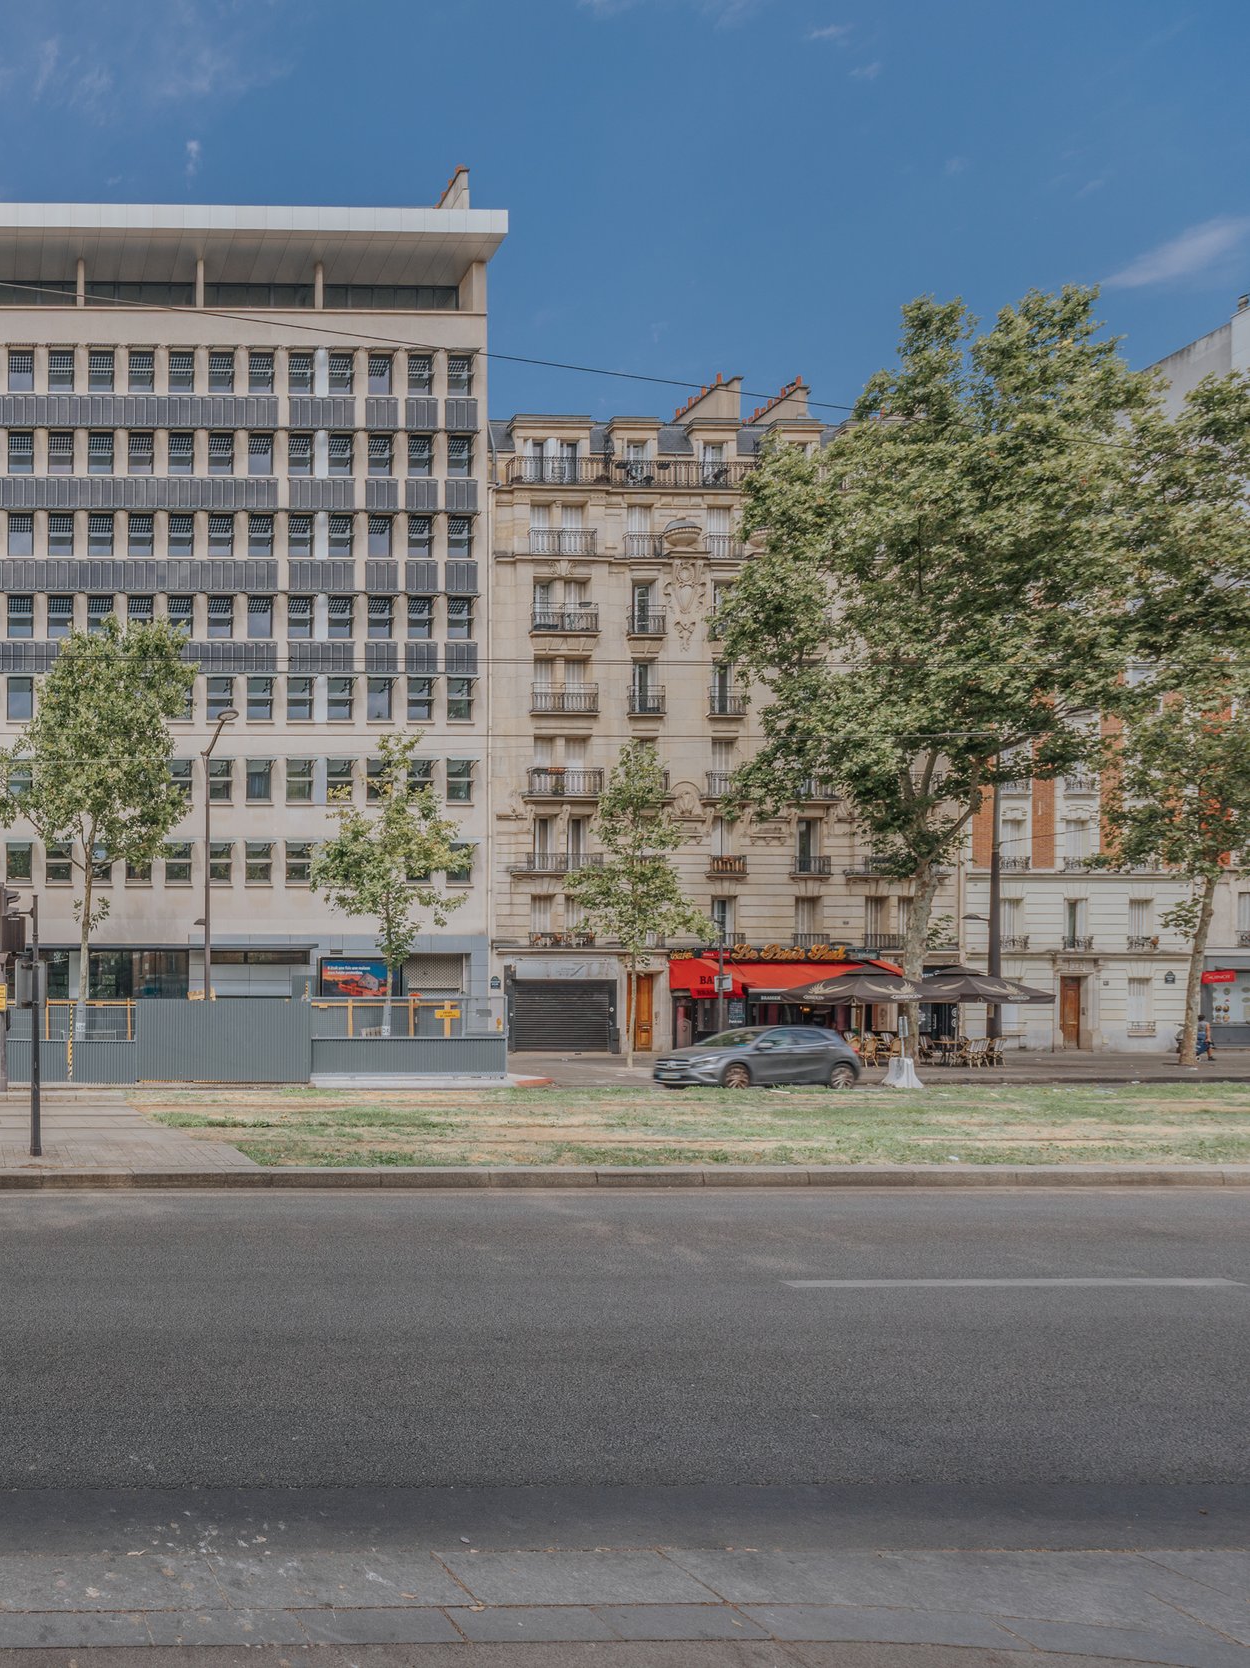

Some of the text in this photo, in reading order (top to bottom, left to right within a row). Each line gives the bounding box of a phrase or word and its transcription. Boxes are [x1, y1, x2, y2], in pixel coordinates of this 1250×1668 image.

[732, 944, 758, 959] Le
[760, 944, 805, 960] Paris
[808, 944, 846, 960] Sud
